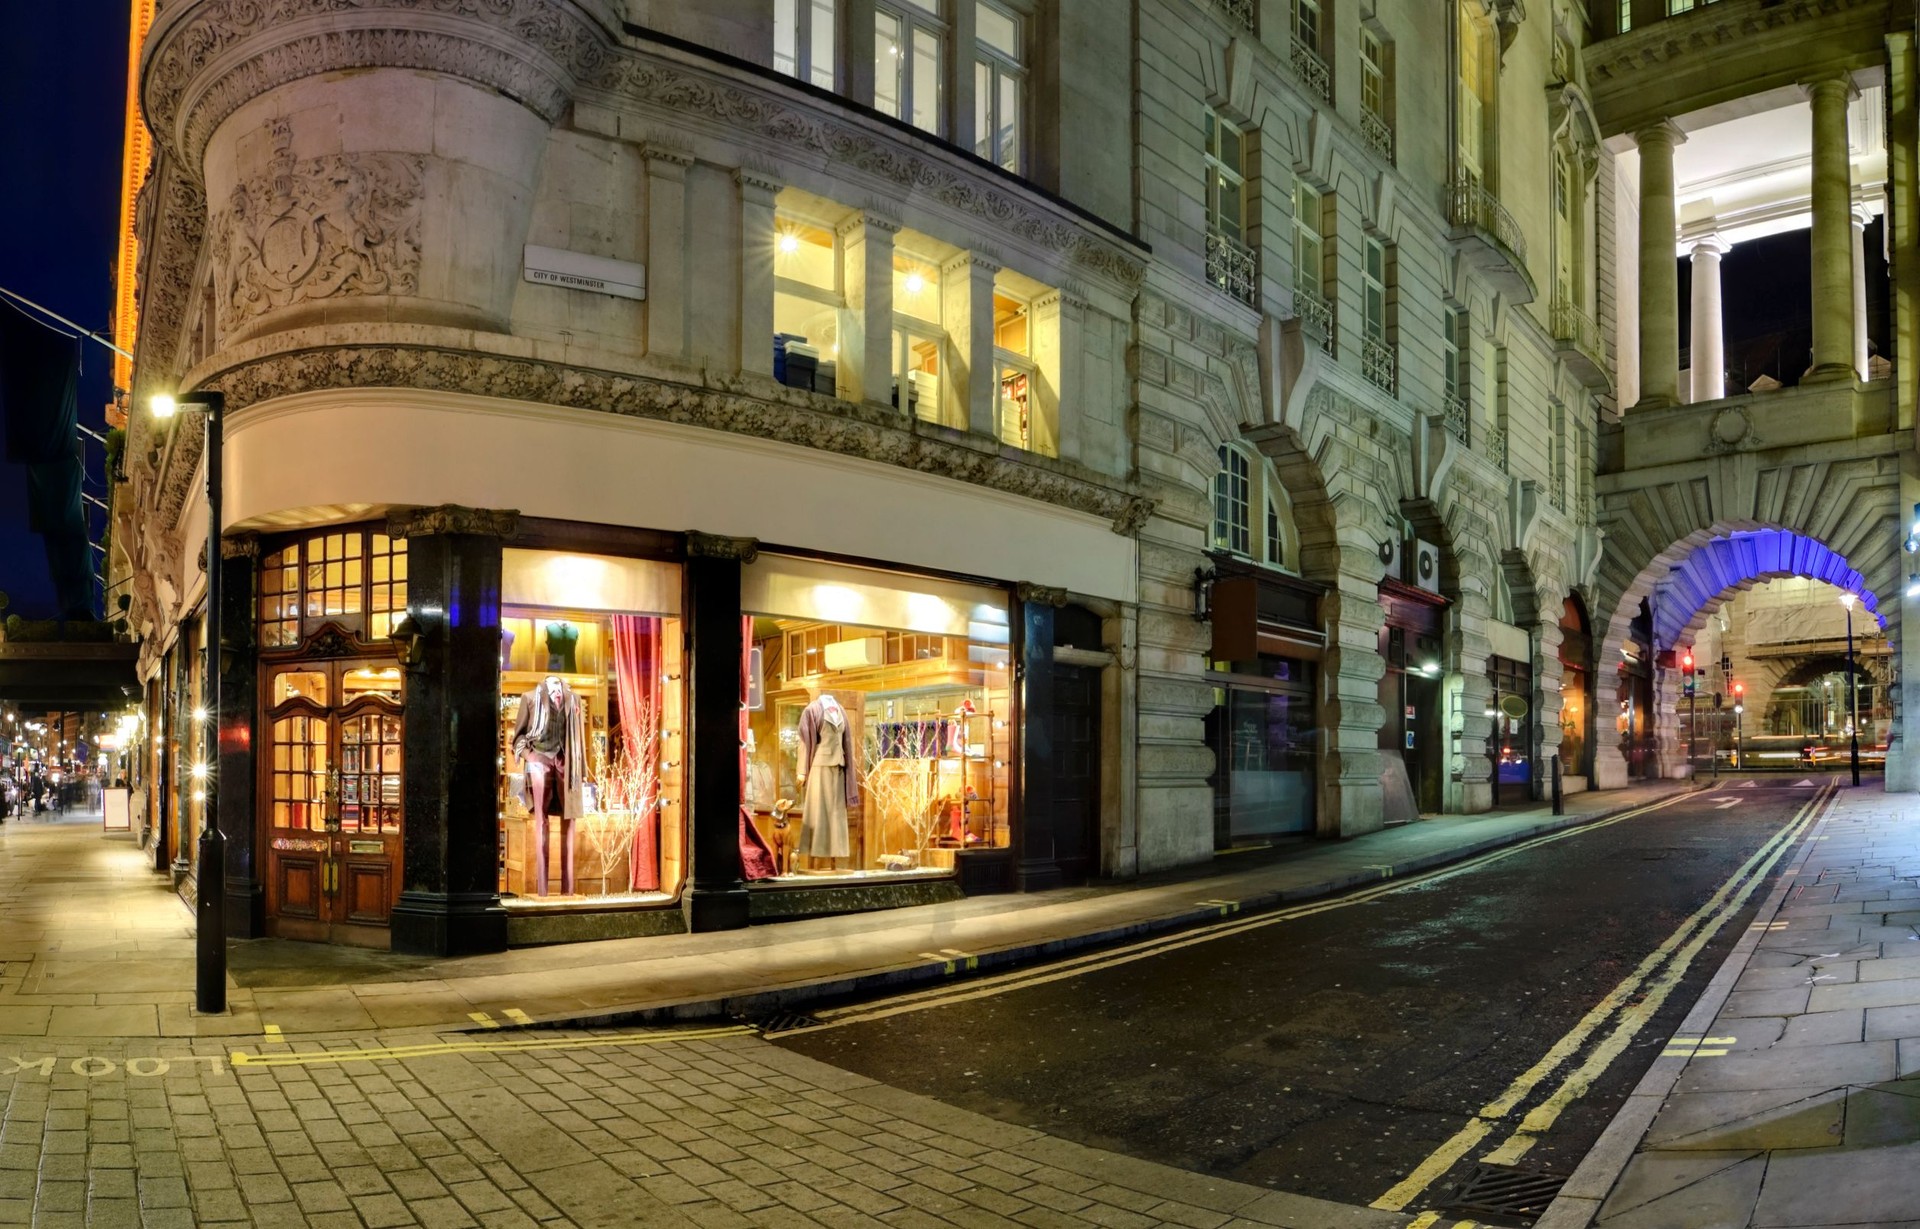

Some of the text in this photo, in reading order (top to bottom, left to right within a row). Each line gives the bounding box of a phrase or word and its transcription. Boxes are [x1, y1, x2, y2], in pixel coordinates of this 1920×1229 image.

[533, 271, 548, 279] CITY
[560, 276, 605, 289] WESTMINSTER
[2, 1056, 226, 1077] LOOK
